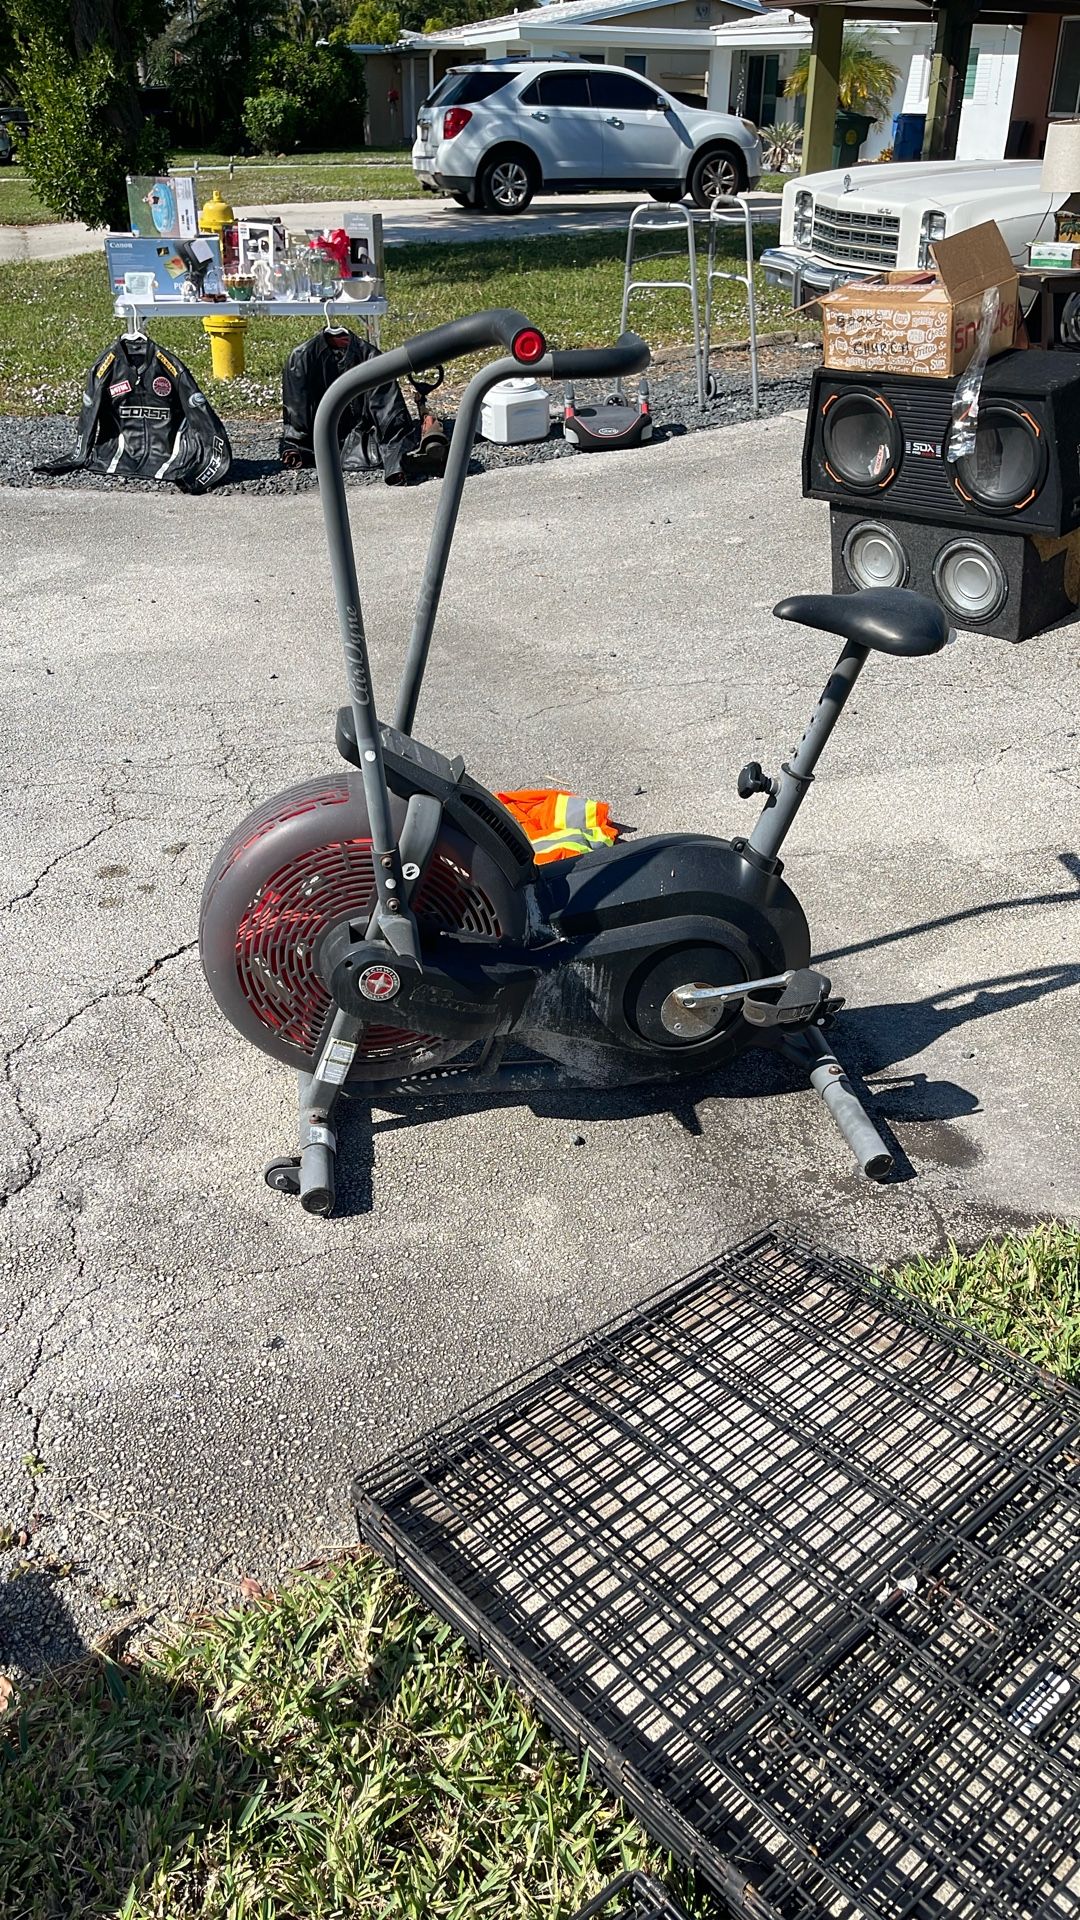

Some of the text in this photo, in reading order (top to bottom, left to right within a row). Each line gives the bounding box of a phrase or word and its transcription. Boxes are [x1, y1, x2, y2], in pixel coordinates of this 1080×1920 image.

[119, 406, 170, 420] CORSA
[912, 442, 935, 453] SDX
[196, 435, 224, 485] CORSA
[364, 967, 398, 987] SCHWINN
[361, 984, 390, 999] QUALITY
